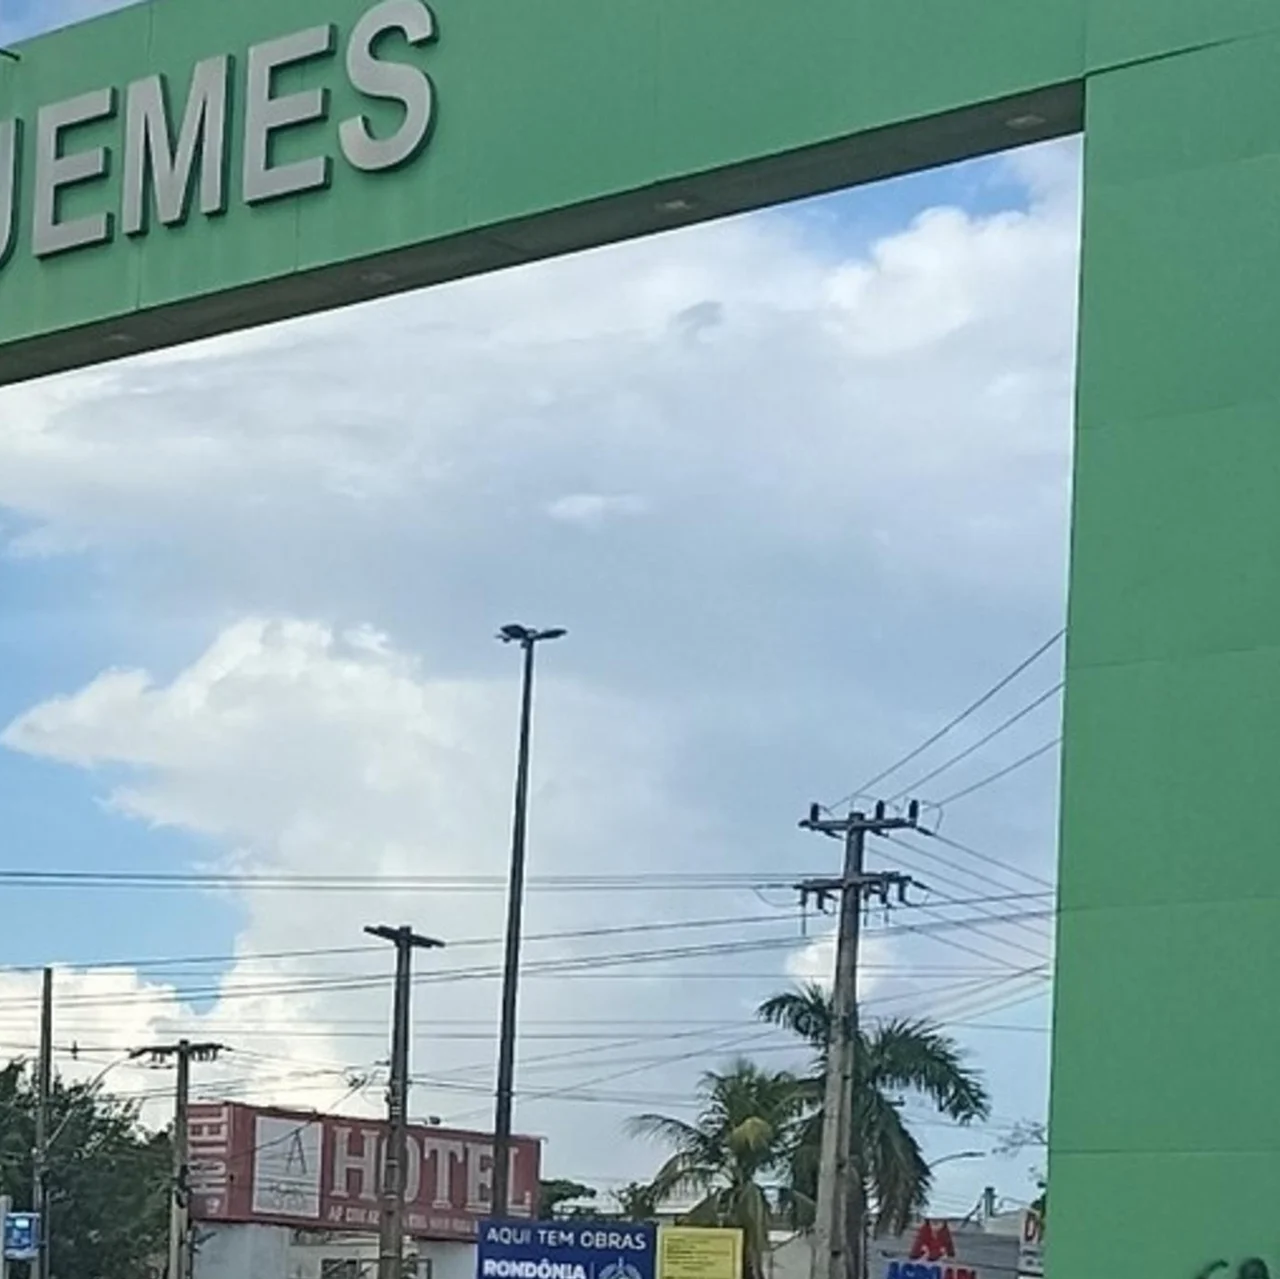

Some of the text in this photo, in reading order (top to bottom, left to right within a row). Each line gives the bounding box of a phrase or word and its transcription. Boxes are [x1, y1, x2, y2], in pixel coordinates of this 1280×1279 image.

[487, 1228, 646, 1249] AQUI TEM OBRAS
